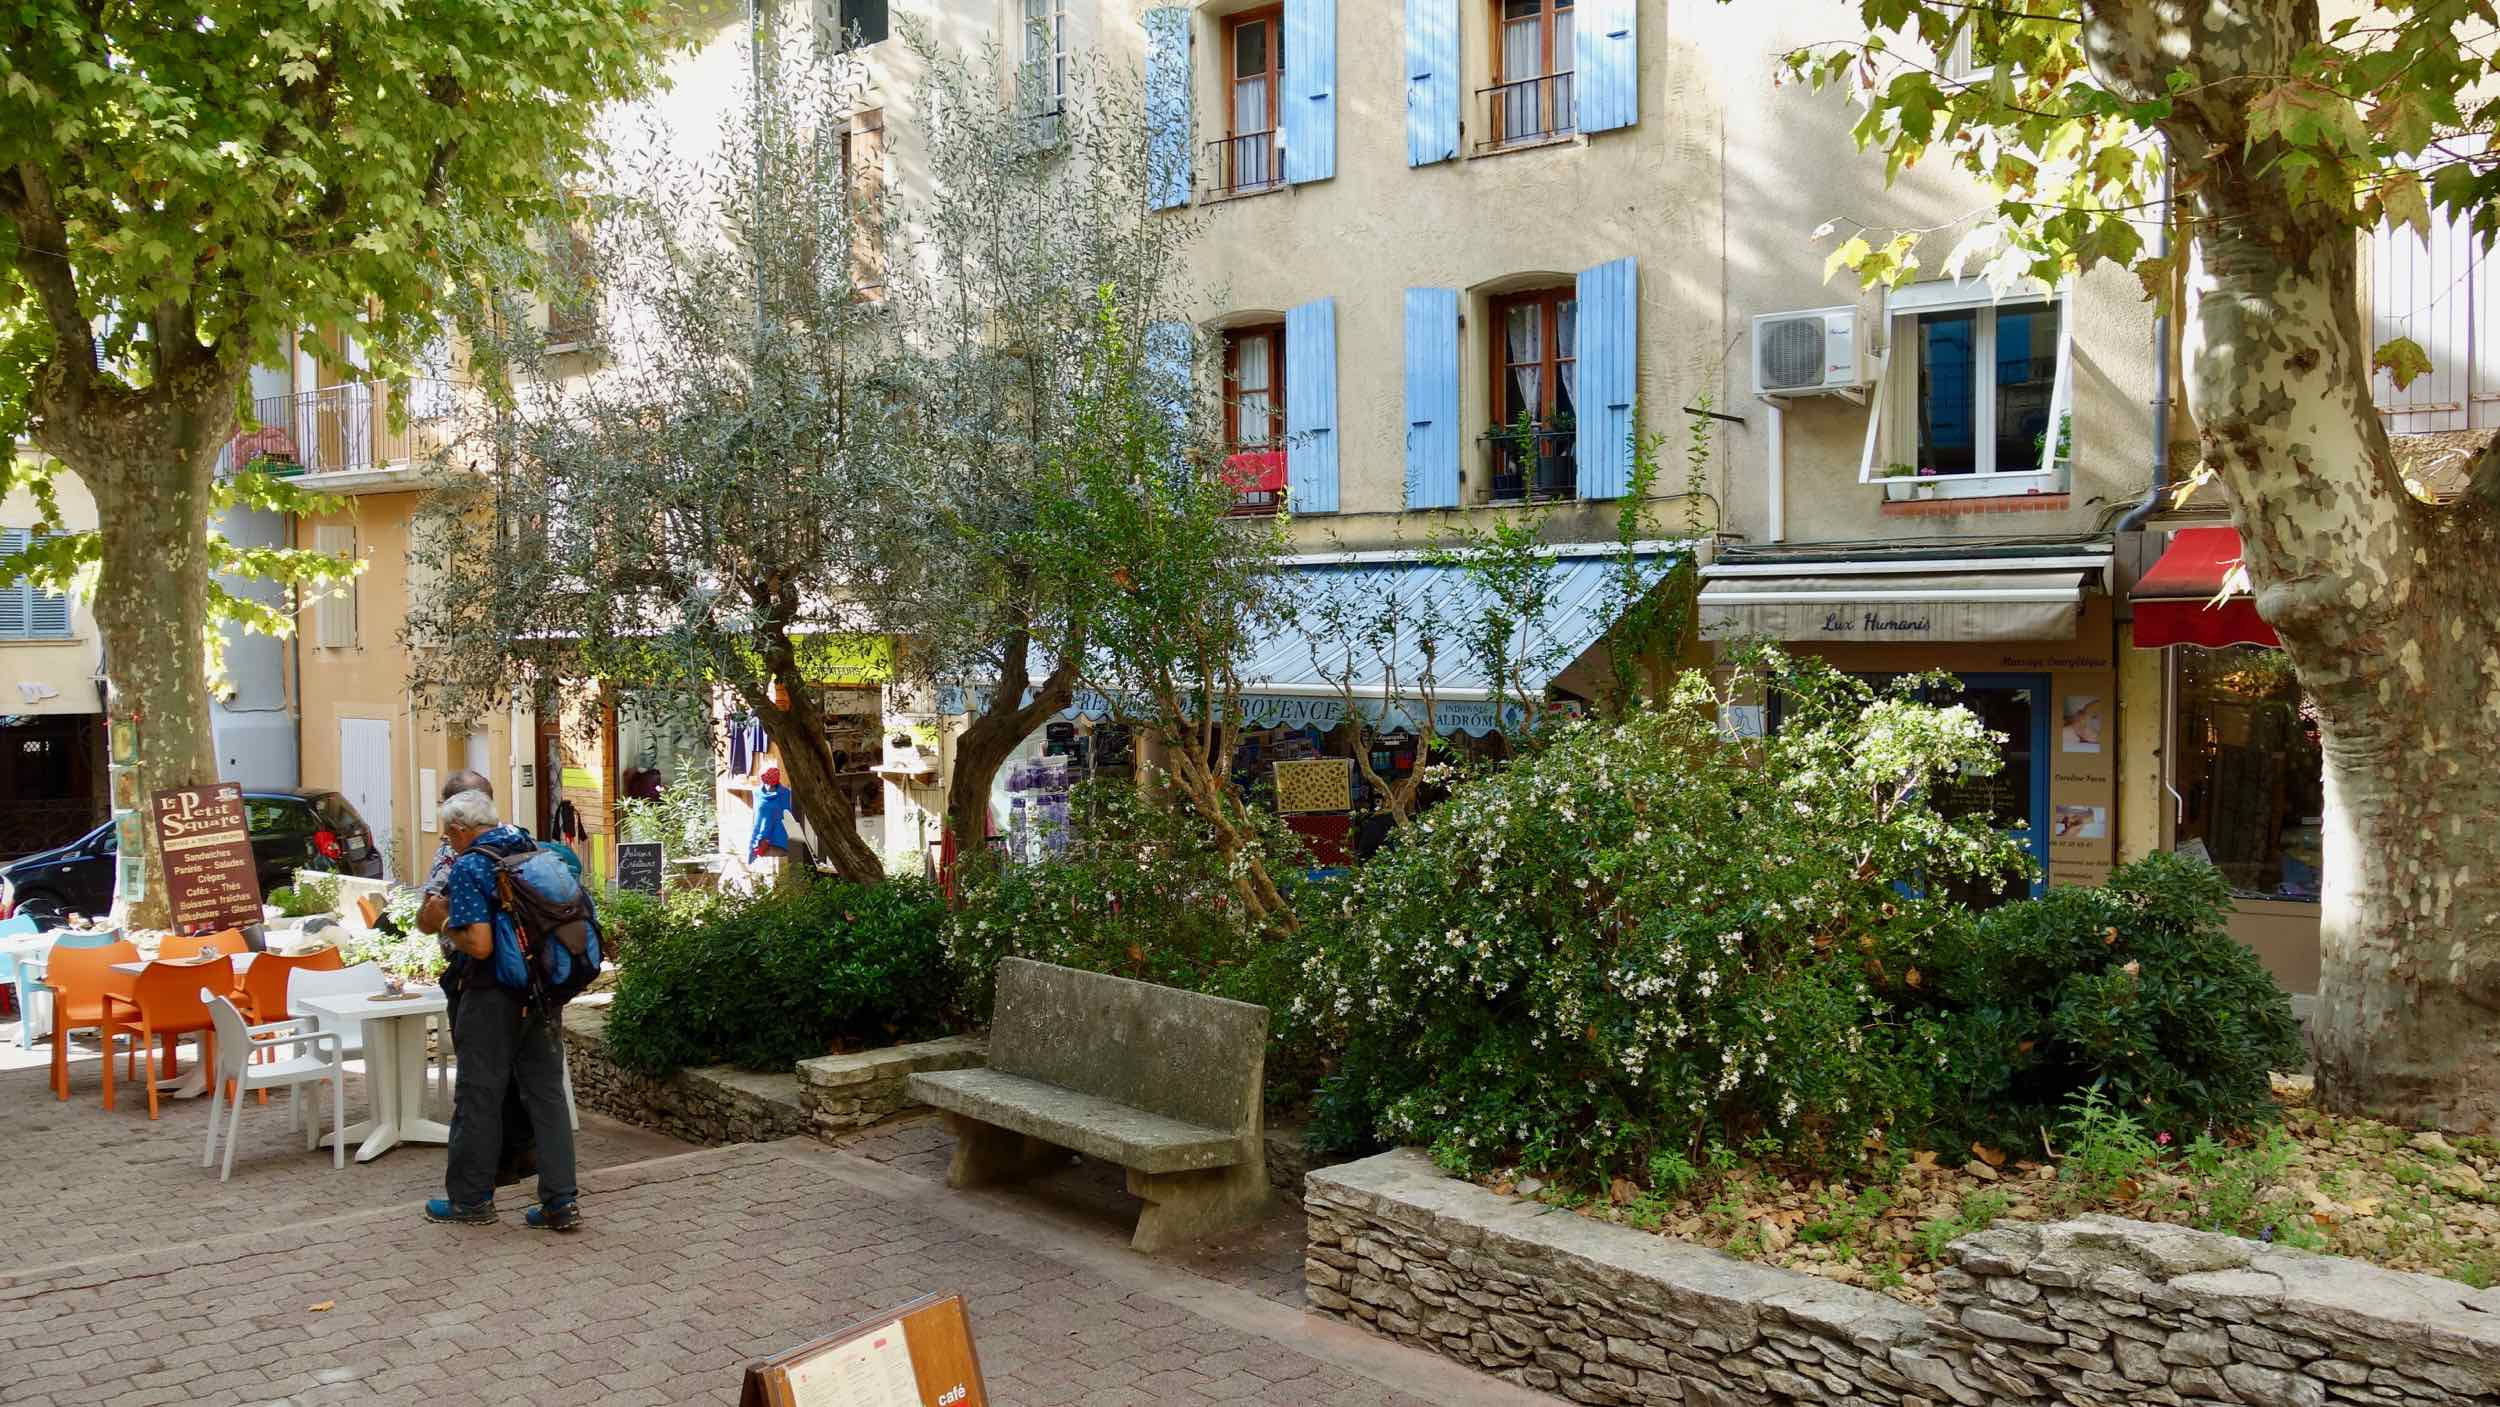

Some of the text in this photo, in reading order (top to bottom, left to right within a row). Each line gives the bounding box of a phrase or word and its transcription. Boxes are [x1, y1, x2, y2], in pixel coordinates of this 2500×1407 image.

[1822, 612, 1930, 632] Lux Humanis
[177, 791, 229, 820] Petit
[162, 813, 241, 836] Square
[184, 849, 231, 863] Sandwiches
[214, 858, 245, 869] Salades
[938, 1383, 966, 1407] café
